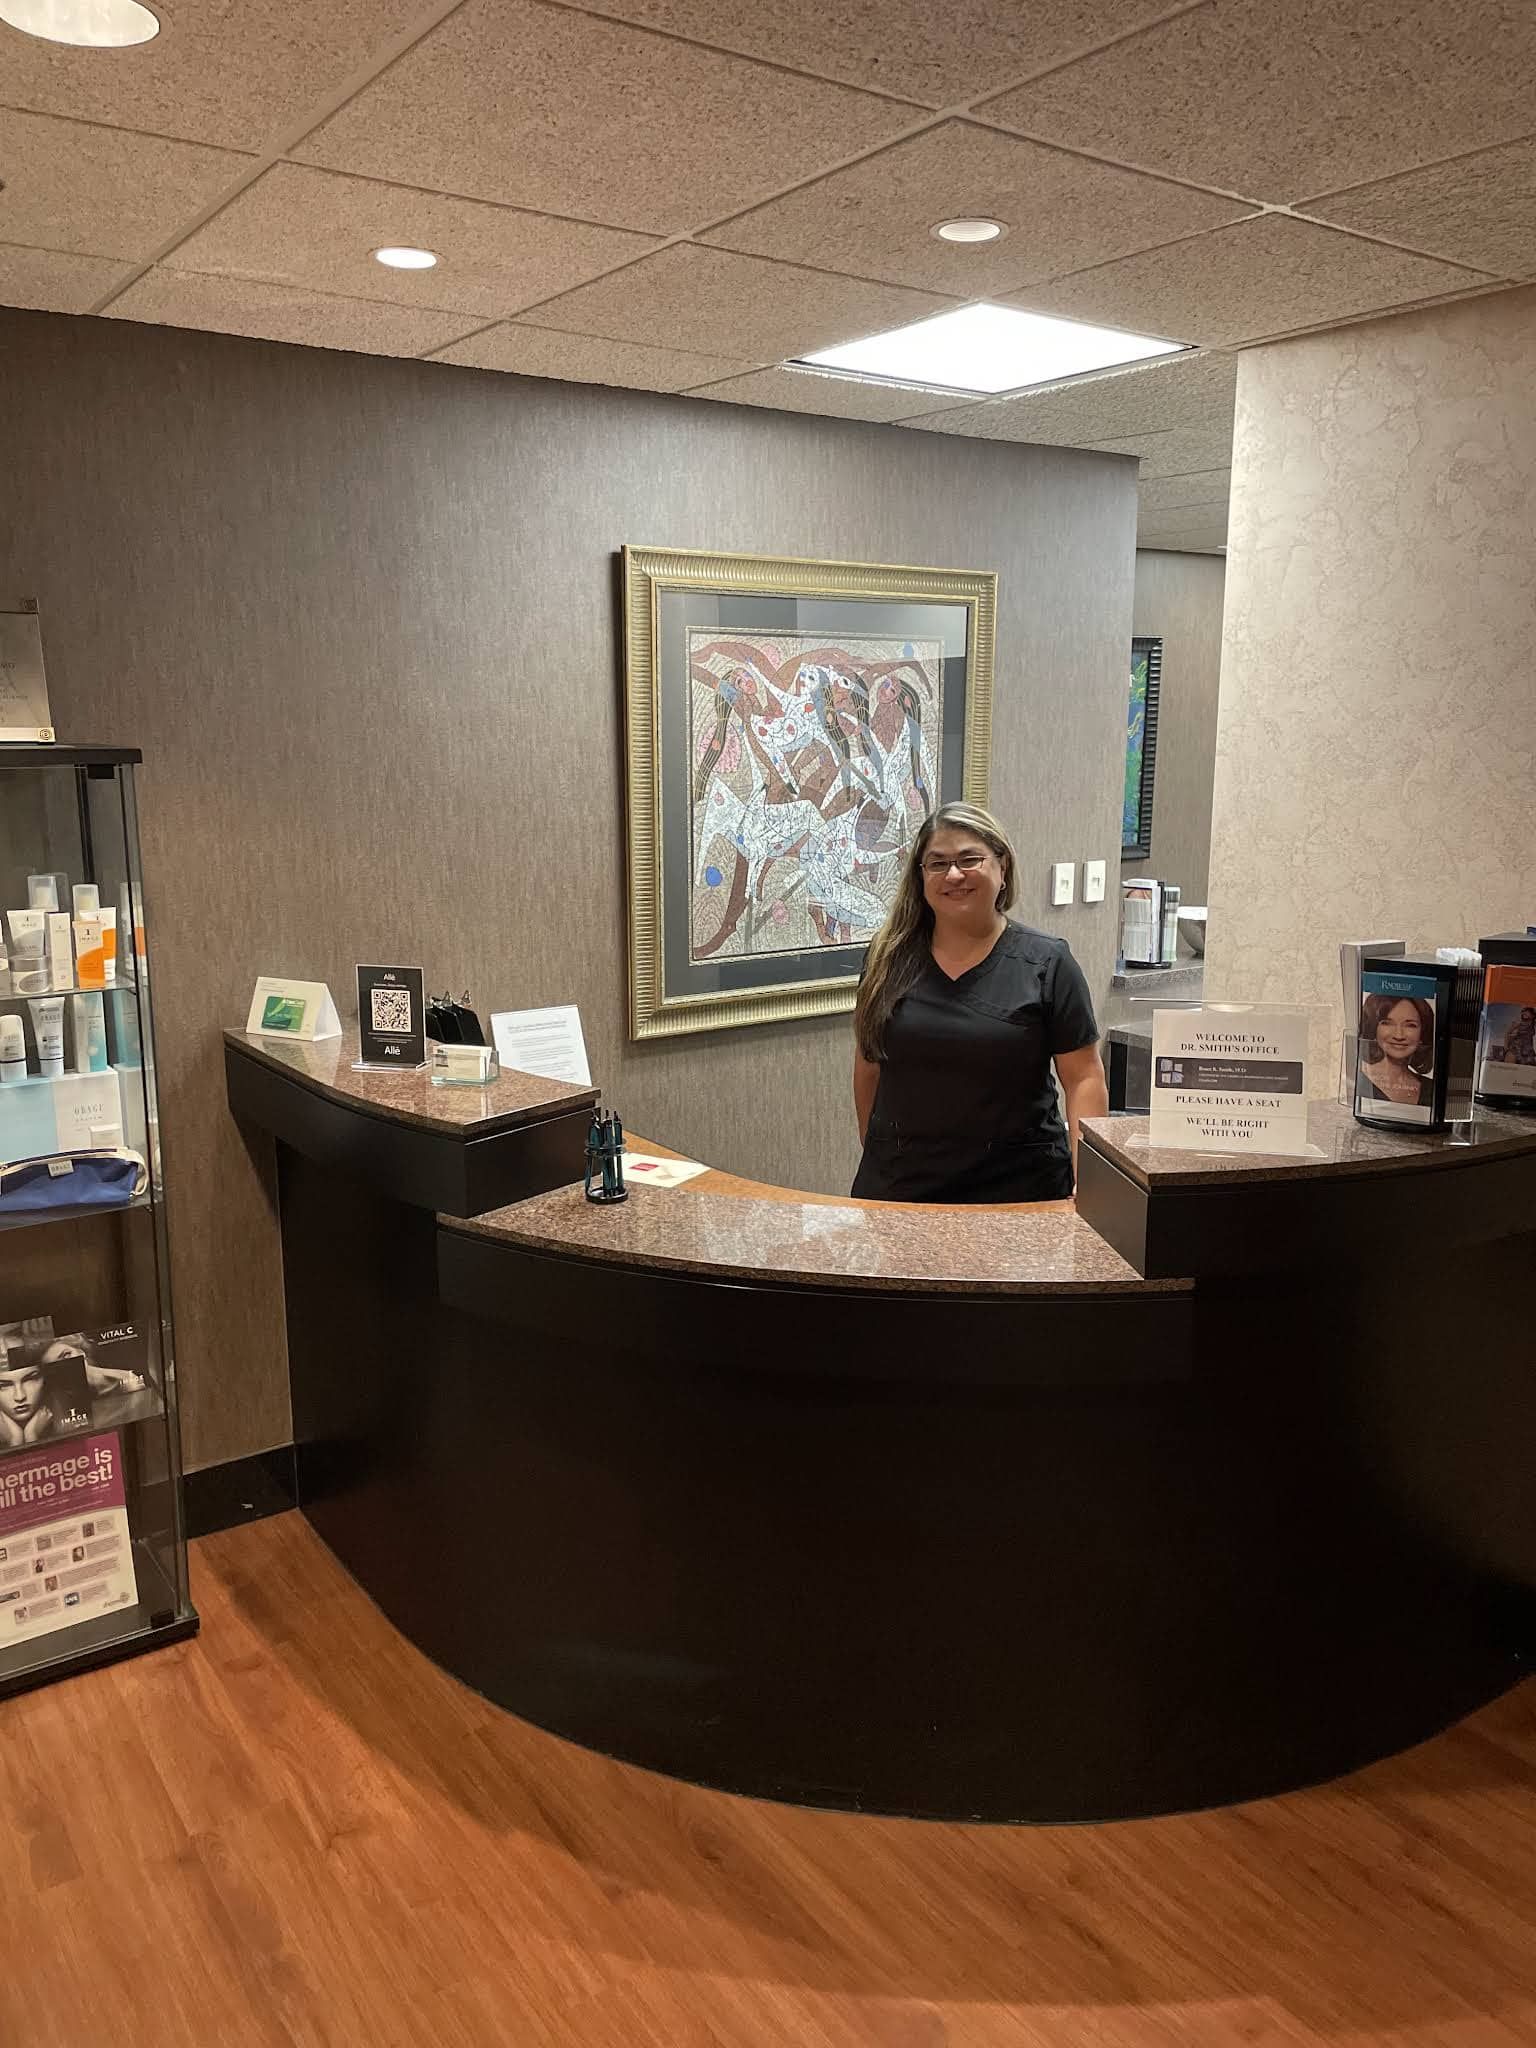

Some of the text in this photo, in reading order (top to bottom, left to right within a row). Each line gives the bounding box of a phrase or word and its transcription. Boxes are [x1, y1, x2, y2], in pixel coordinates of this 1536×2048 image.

[1196, 1033, 1265, 1043] WELCOME TO
[1180, 1043, 1280, 1054] DR. SMITH'S OFFICE
[1176, 1095, 1281, 1107] PLEASE HAVE A SEAT
[1186, 1117, 1269, 1128] WE'LL BE RIGHT
[1201, 1128, 1253, 1138] WITH YOU
[100, 1328, 125, 1340] VITAL
[127, 1326, 134, 1334] C
[61, 1413, 87, 1424] IMAGE
[94, 1447, 113, 1465] is
[19, 1481, 57, 1502] the
[60, 1463, 113, 1492] best!
